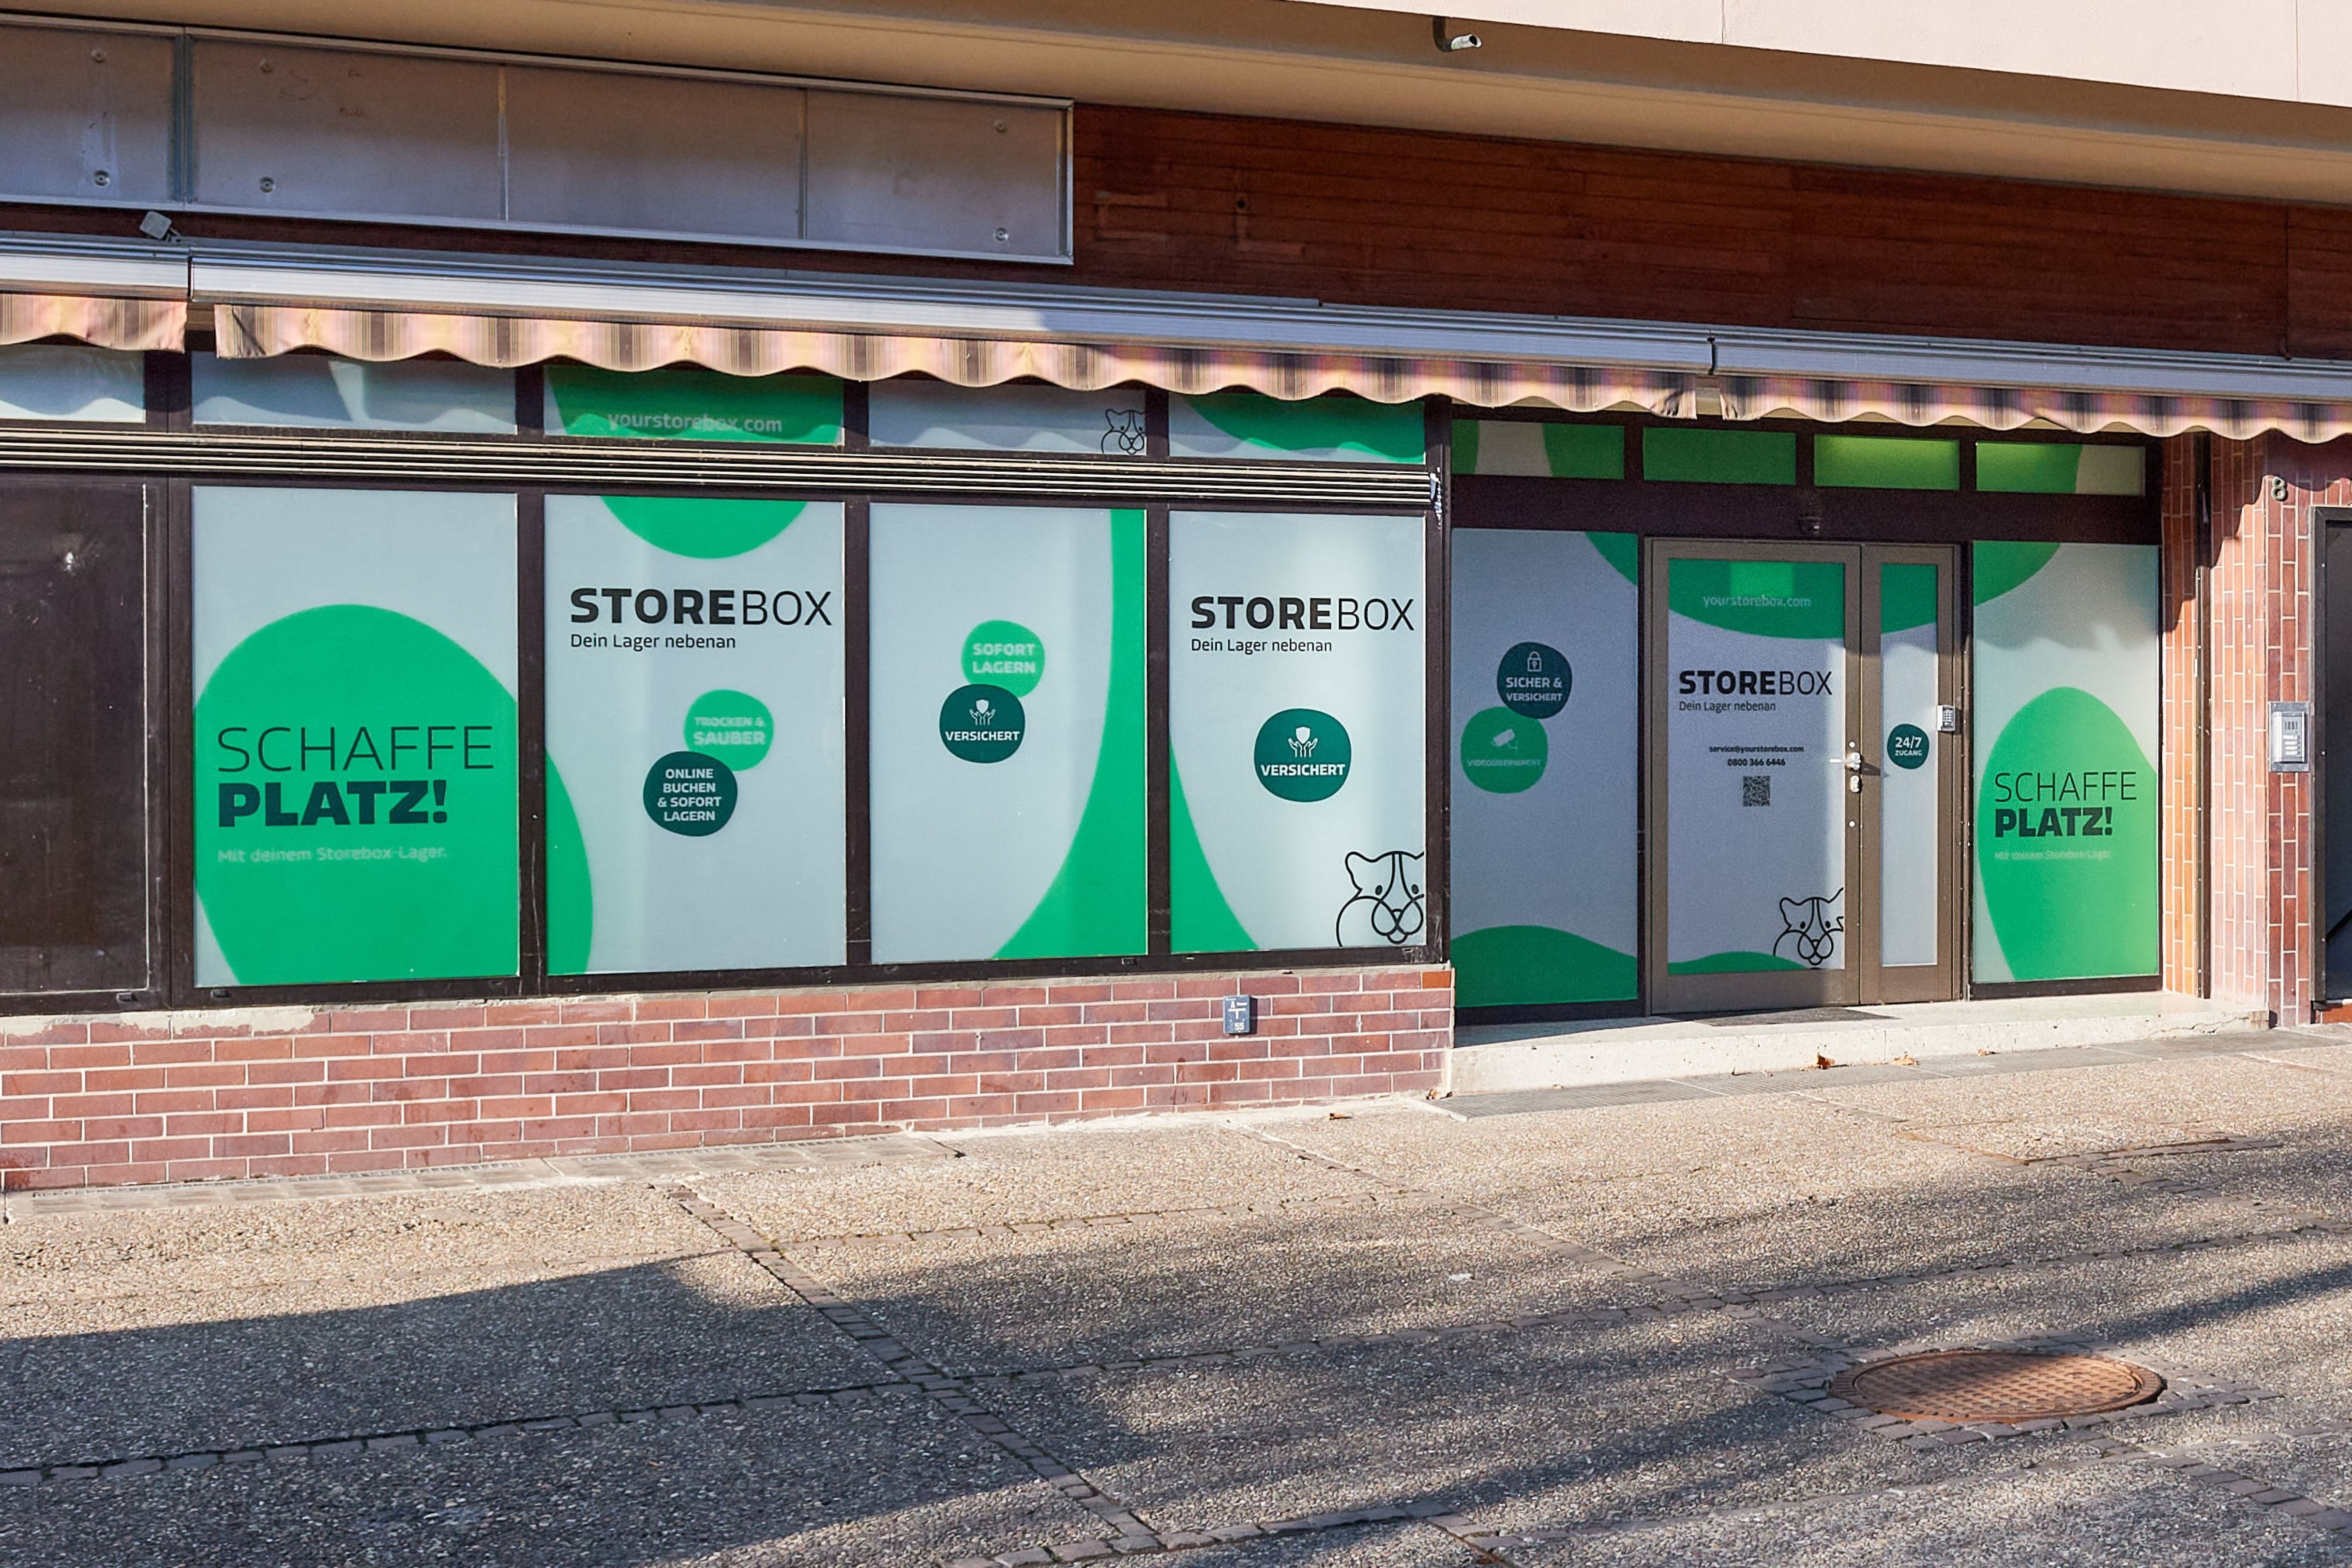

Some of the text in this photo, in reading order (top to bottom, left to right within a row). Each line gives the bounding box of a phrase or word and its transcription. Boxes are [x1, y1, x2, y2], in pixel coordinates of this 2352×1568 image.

[608, 413, 782, 432] yourstorebox.com
[2271, 476, 2286, 499] 8
[571, 588, 832, 625] STOREBOX
[1703, 595, 1811, 607] yourstorebox.com
[1191, 596, 1414, 631] STOREBOX
[571, 633, 735, 651] Dein Lager nebenan
[1191, 639, 1332, 655] Dein Lager nebenan
[972, 643, 1036, 655] SOFORT
[972, 661, 1036, 674] LAGERN
[1506, 678, 1562, 688] SICHER &
[1679, 670, 1832, 695] STOREBOX
[1506, 693, 1562, 701] VERSICHERT
[1679, 701, 1776, 713] Dein Lager nebenan
[694, 717, 765, 727] TROCKEN &
[693, 731, 765, 745] SAUBER
[945, 731, 1020, 741] VERSICHERT
[1895, 736, 1922, 748] 24/7
[218, 726, 494, 772] SCHAFFE
[1709, 745, 1804, 754] service@yourstorebox.com
[665, 769, 714, 779] ONLINE
[1261, 764, 1345, 776] VERSICHERT
[663, 783, 716, 793] BUCHEN
[1994, 771, 2137, 802] SCHAFFE
[219, 780, 447, 827] PLATZ!
[657, 797, 722, 807] & SOFORT
[664, 811, 715, 821] LAGERN
[1995, 807, 2112, 837] PLATZ!
[218, 849, 245, 863] Mit
[250, 847, 312, 862] deinem
